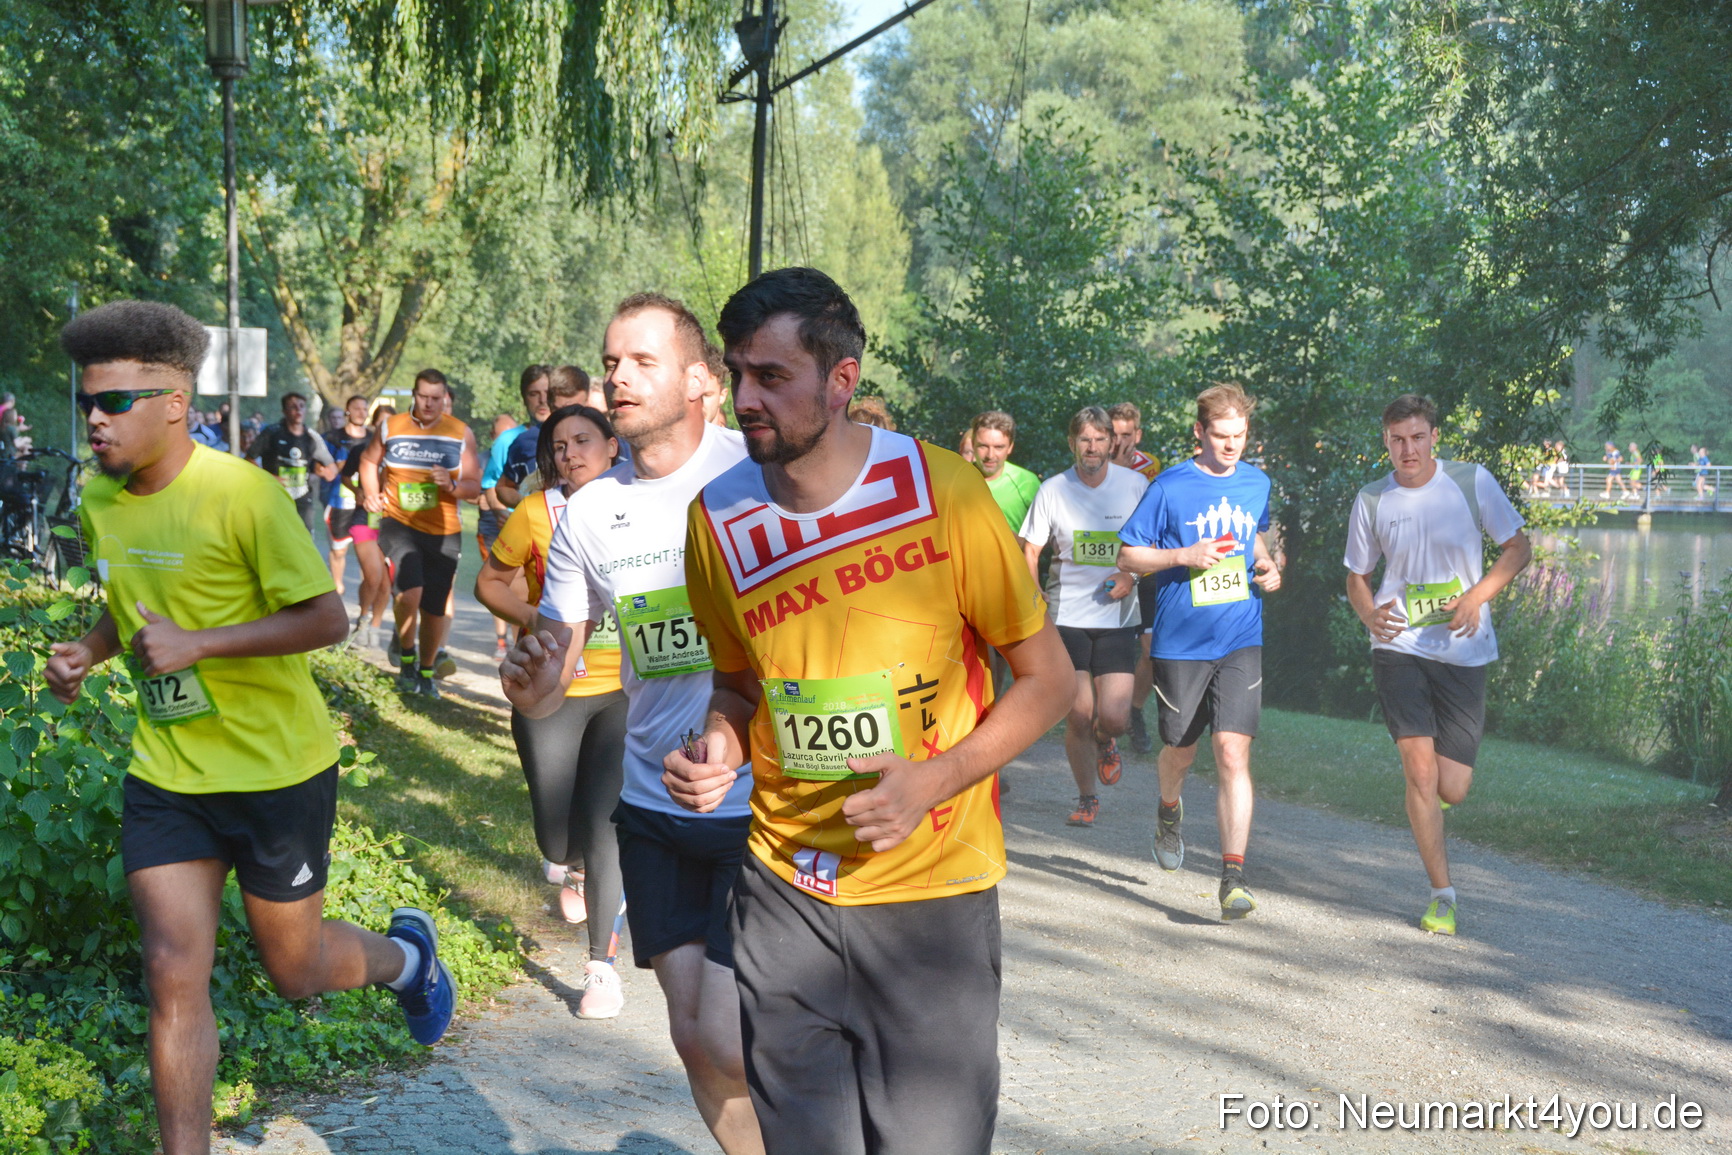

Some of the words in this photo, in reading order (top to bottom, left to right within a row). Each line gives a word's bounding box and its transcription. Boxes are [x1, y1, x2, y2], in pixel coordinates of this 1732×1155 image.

[397, 442, 446, 460] Fischer
[1079, 543, 1115, 556] 1381
[598, 549, 670, 575] RUPPRECHT
[743, 576, 829, 639] MAX
[834, 536, 950, 596] BÖGL
[1199, 572, 1241, 592] 1354
[646, 654, 670, 664] Walter
[672, 648, 705, 660] Andreas
[142, 676, 188, 706] 972
[779, 692, 816, 704] firmenlauf
[822, 700, 847, 711] 2018
[784, 712, 880, 751] 1260
[782, 749, 814, 762] Lazurca
[806, 762, 820, 771] Bögl
[821, 763, 850, 771] Bauserv
